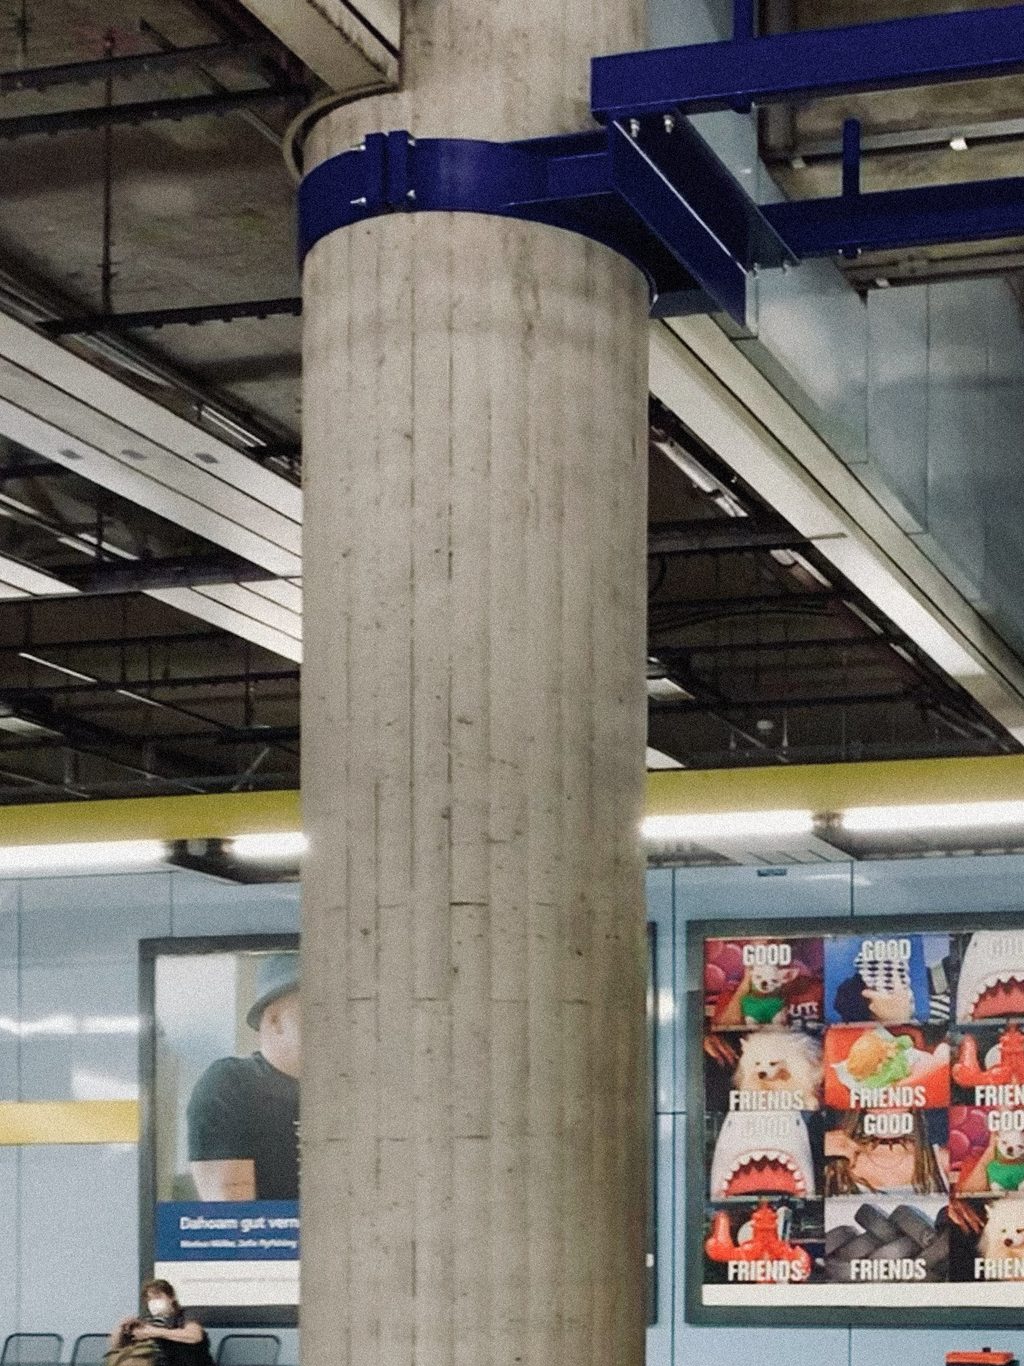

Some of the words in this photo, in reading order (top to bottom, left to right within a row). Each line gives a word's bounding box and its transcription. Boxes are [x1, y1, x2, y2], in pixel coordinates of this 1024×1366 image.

[742, 944, 791, 966] GOOD
[861, 938, 911, 961] GOOD
[729, 1089, 802, 1111] FRIENDS
[850, 1086, 926, 1108] FRIENDS
[863, 1113, 913, 1135] GOOD
[240, 1217, 266, 1233] gut
[727, 1259, 801, 1281] FRIENDS
[850, 1258, 927, 1280] FRIENDS
